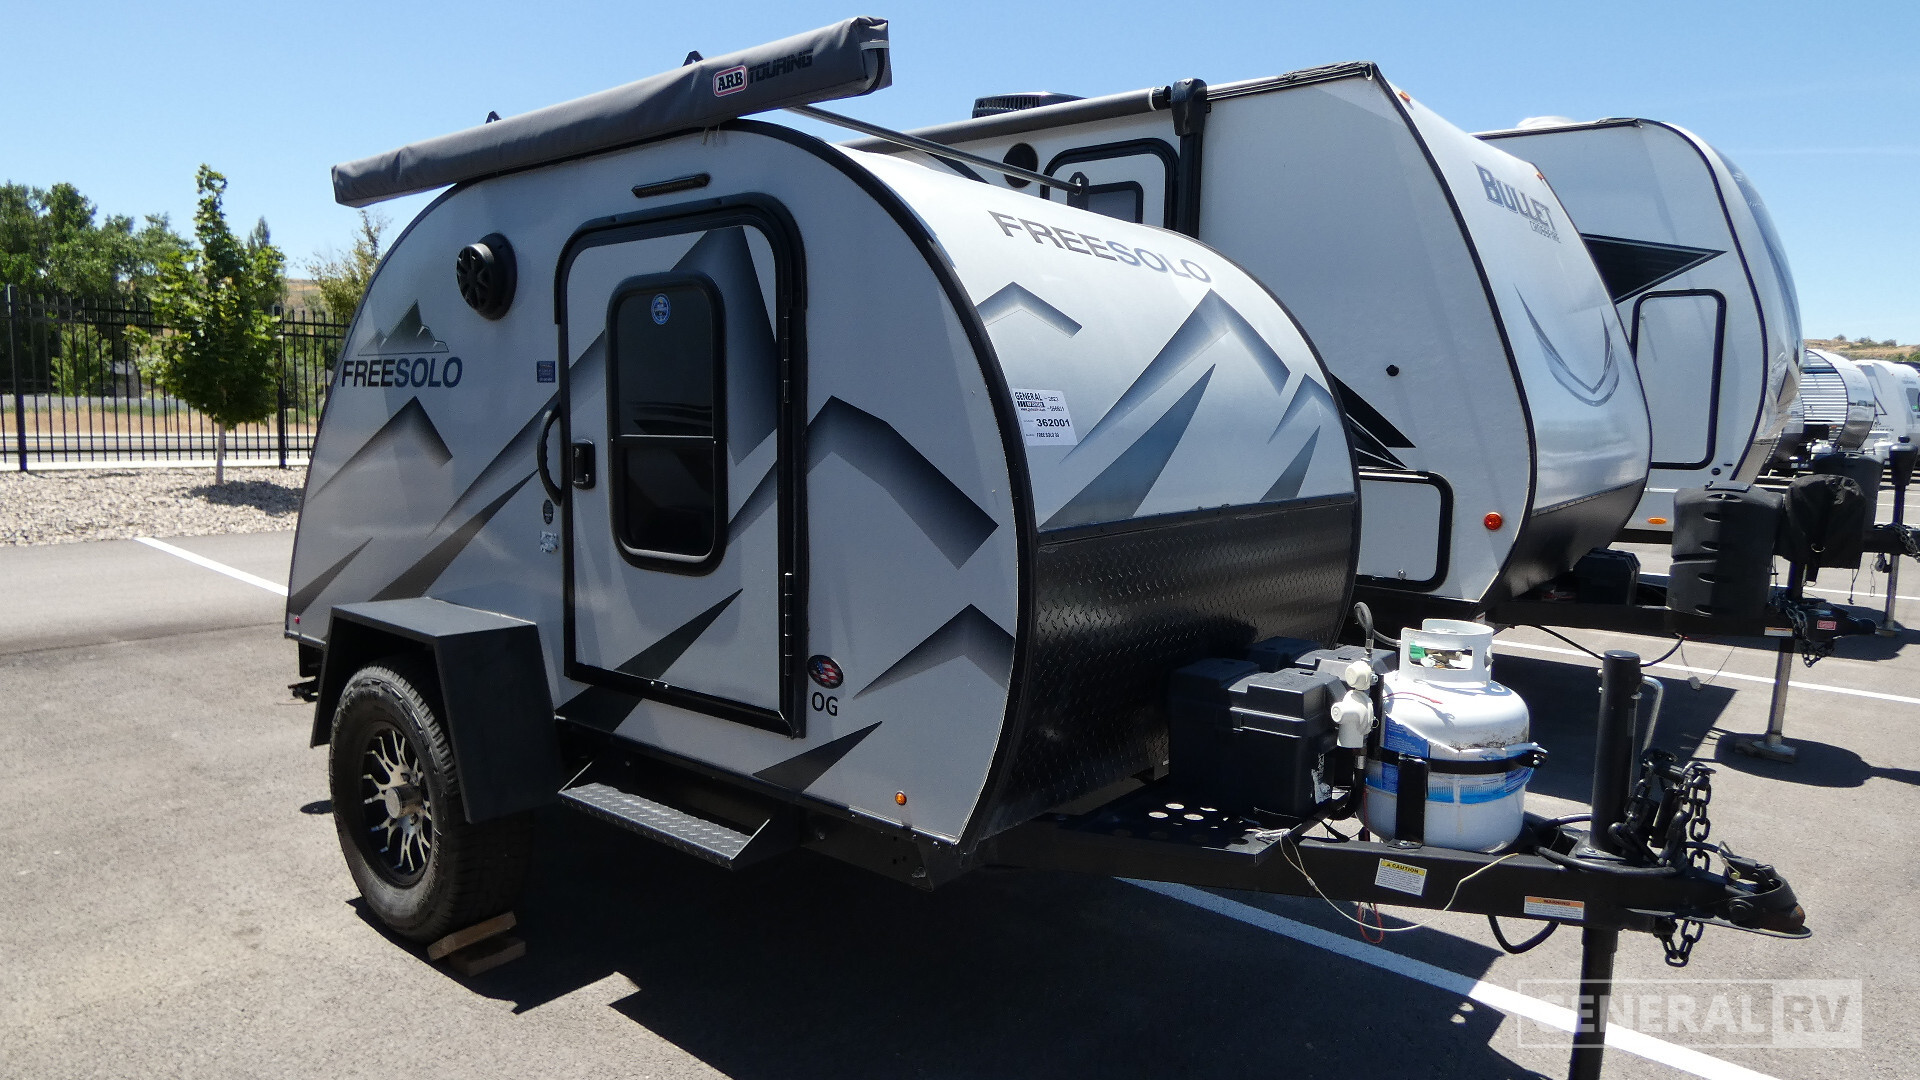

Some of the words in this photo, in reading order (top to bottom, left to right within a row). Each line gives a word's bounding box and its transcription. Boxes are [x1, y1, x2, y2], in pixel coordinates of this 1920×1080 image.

[717, 71, 744, 92] ARB
[748, 50, 814, 84] TOURING
[1475, 164, 1556, 233] BULLET
[987, 210, 1212, 283] FREESOLO
[341, 356, 463, 388] FREESOLO
[1014, 391, 1043, 401] GENERAL
[1036, 418, 1071, 427] 362001
[812, 691, 839, 717] OG
[1392, 863, 1419, 874] CAUTION
